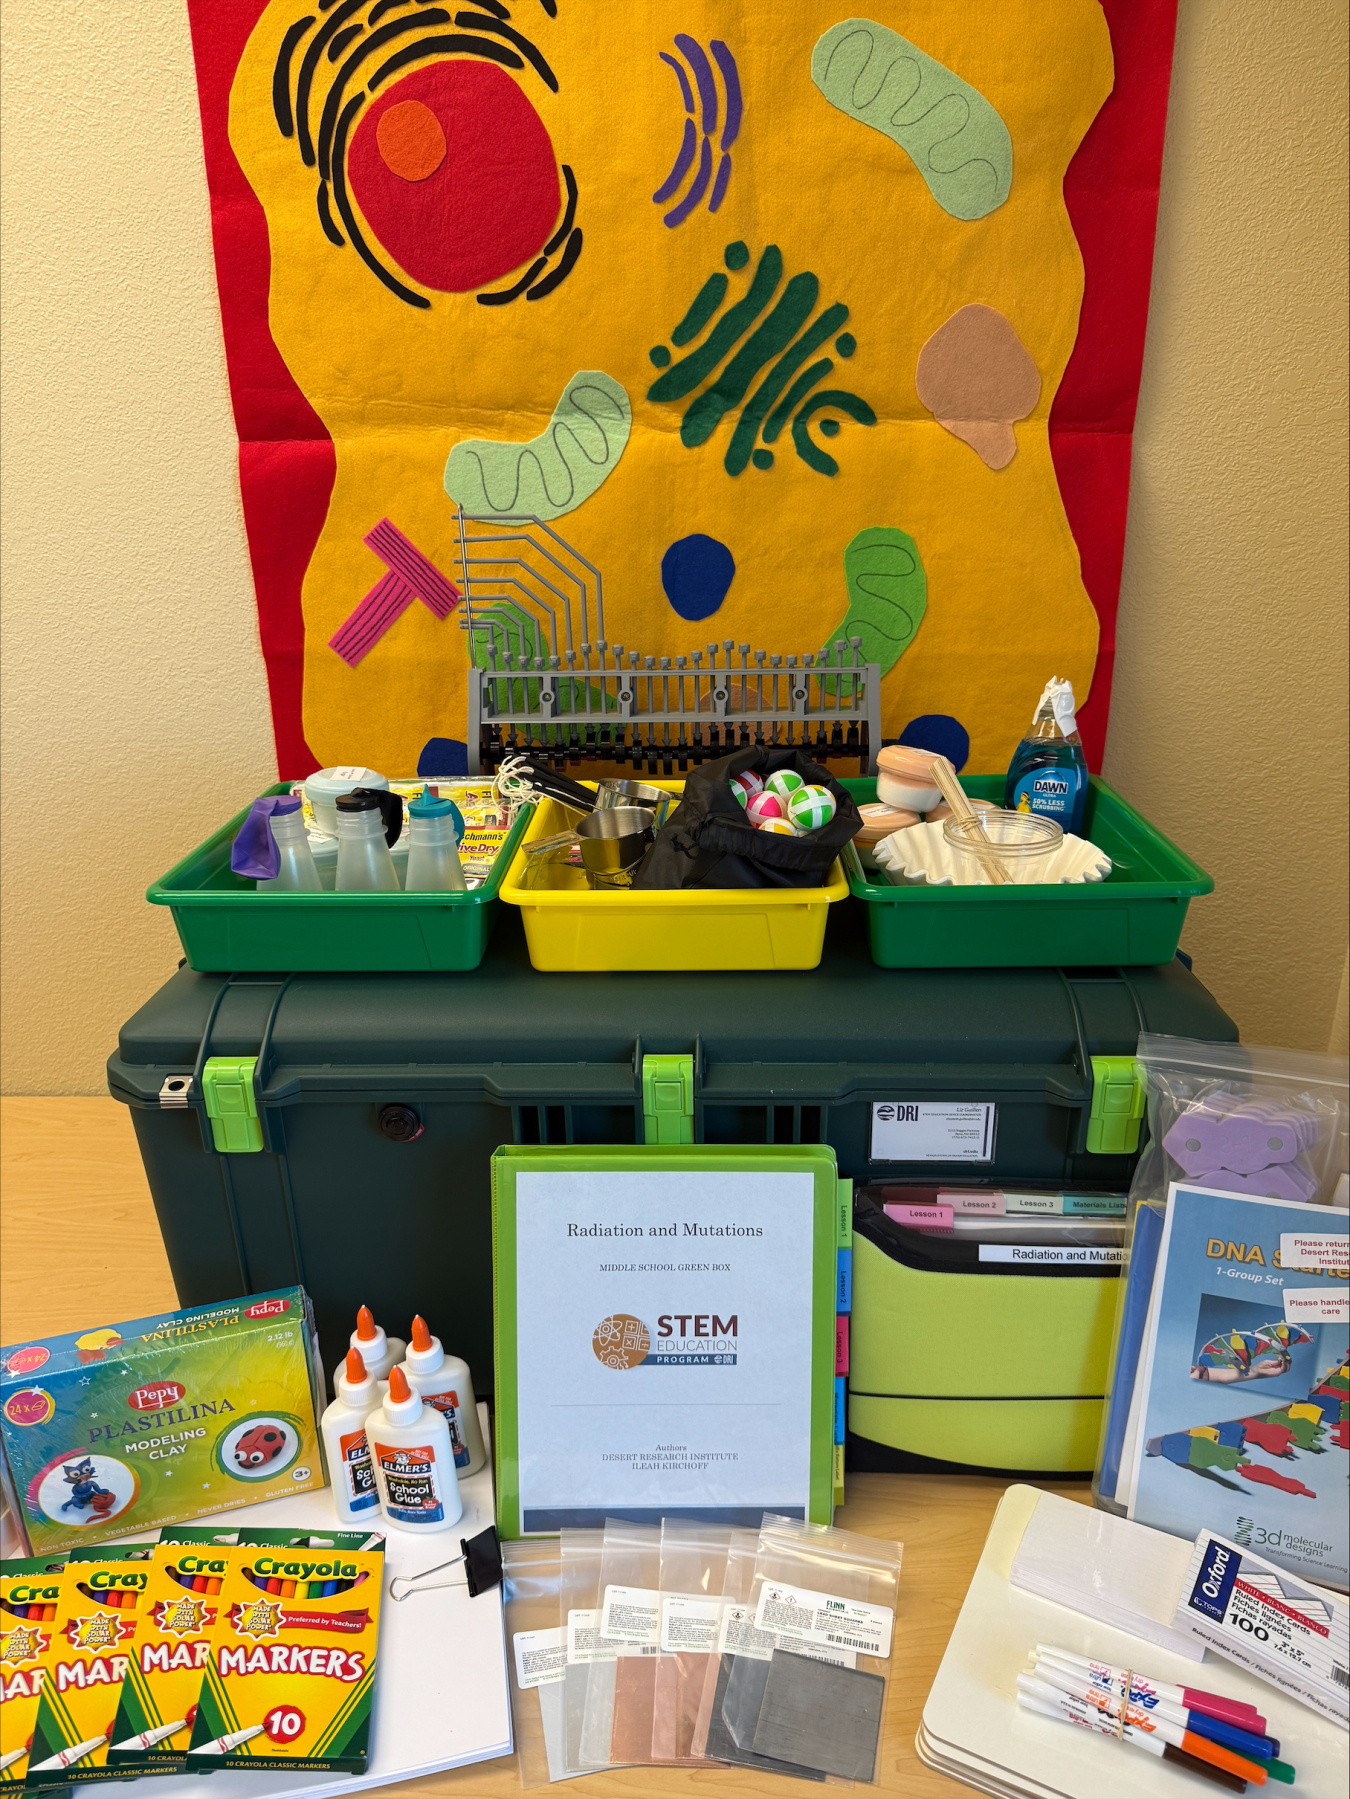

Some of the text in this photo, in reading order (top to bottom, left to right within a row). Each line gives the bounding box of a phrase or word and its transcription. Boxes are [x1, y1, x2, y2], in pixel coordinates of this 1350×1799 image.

[1034, 781, 1068, 793] DAWN
[1032, 804, 1065, 812] SCRUBBING
[897, 1106, 918, 1121] DRI
[962, 1200, 990, 1208] Lesson
[910, 1210, 937, 1218] Lesson
[567, 1223, 763, 1237] Radiation and Mutations
[1012, 1248, 1086, 1260] Radiation and
[1206, 1238, 1265, 1266] DNA
[600, 1264, 730, 1272] MIDDLE SCHOOL GREEN BOX
[1216, 1267, 1284, 1285] 1-Group Set
[251, 1300, 284, 1316] Pepy
[156, 1306, 240, 1329] MODELING CLAY
[657, 1314, 738, 1337] STEM
[141, 1316, 240, 1343] PLASTILINA
[268, 1334, 285, 1342] 2.12
[658, 1340, 737, 1351] EDUCATION
[136, 1386, 180, 1408] Pepy
[10, 1405, 22, 1415] 24
[87, 1398, 235, 1443] PLASTILINA
[125, 1427, 206, 1454] MODELING
[149, 1444, 187, 1460] CLAY
[640, 1453, 688, 1461] RESEARCH
[294, 1470, 309, 1478] 3+
[384, 1462, 428, 1473] ELMER'S
[632, 1462, 709, 1470] ILEAH KIRCHOFF
[390, 1482, 429, 1494] School
[395, 1493, 421, 1504] Glue
[40, 1482, 314, 1552] NON TOXIC VEGETABLE BASED NEVER DRIES GLUTEN FREE
[1254, 1528, 1282, 1546] 3d
[1284, 1534, 1333, 1552] molecular
[1286, 1541, 1324, 1557] designs
[1266, 1547, 1348, 1573] Transforming Science Learning
[254, 1558, 357, 1580] Crayola
[1202, 1546, 1229, 1598] Oxford
[826, 1600, 845, 1610] FLINN
[1202, 1601, 1223, 1615] TOPS
[1236, 1589, 1310, 1635] Ruled Index Cards
[1238, 1581, 1327, 1634] WHITE BLANC BLANCO
[1232, 1602, 1292, 1640] Fichas rayadas
[1234, 1596, 1292, 1632] Fiches lignées
[331, 1620, 362, 1628] Teachers!
[1229, 1613, 1269, 1642] 100
[87, 1630, 110, 1638] SOLAR
[220, 1647, 363, 1681] MARKERS
[1192, 1628, 1211, 1641] Ruled
[1212, 1639, 1230, 1652] Index
[1232, 1650, 1250, 1664] Cards
[1255, 1665, 1276, 1679] Fiches
[1277, 1678, 1302, 1693] lignées
[1307, 1693, 1328, 1710] Fichas
[270, 1710, 300, 1735] 10
